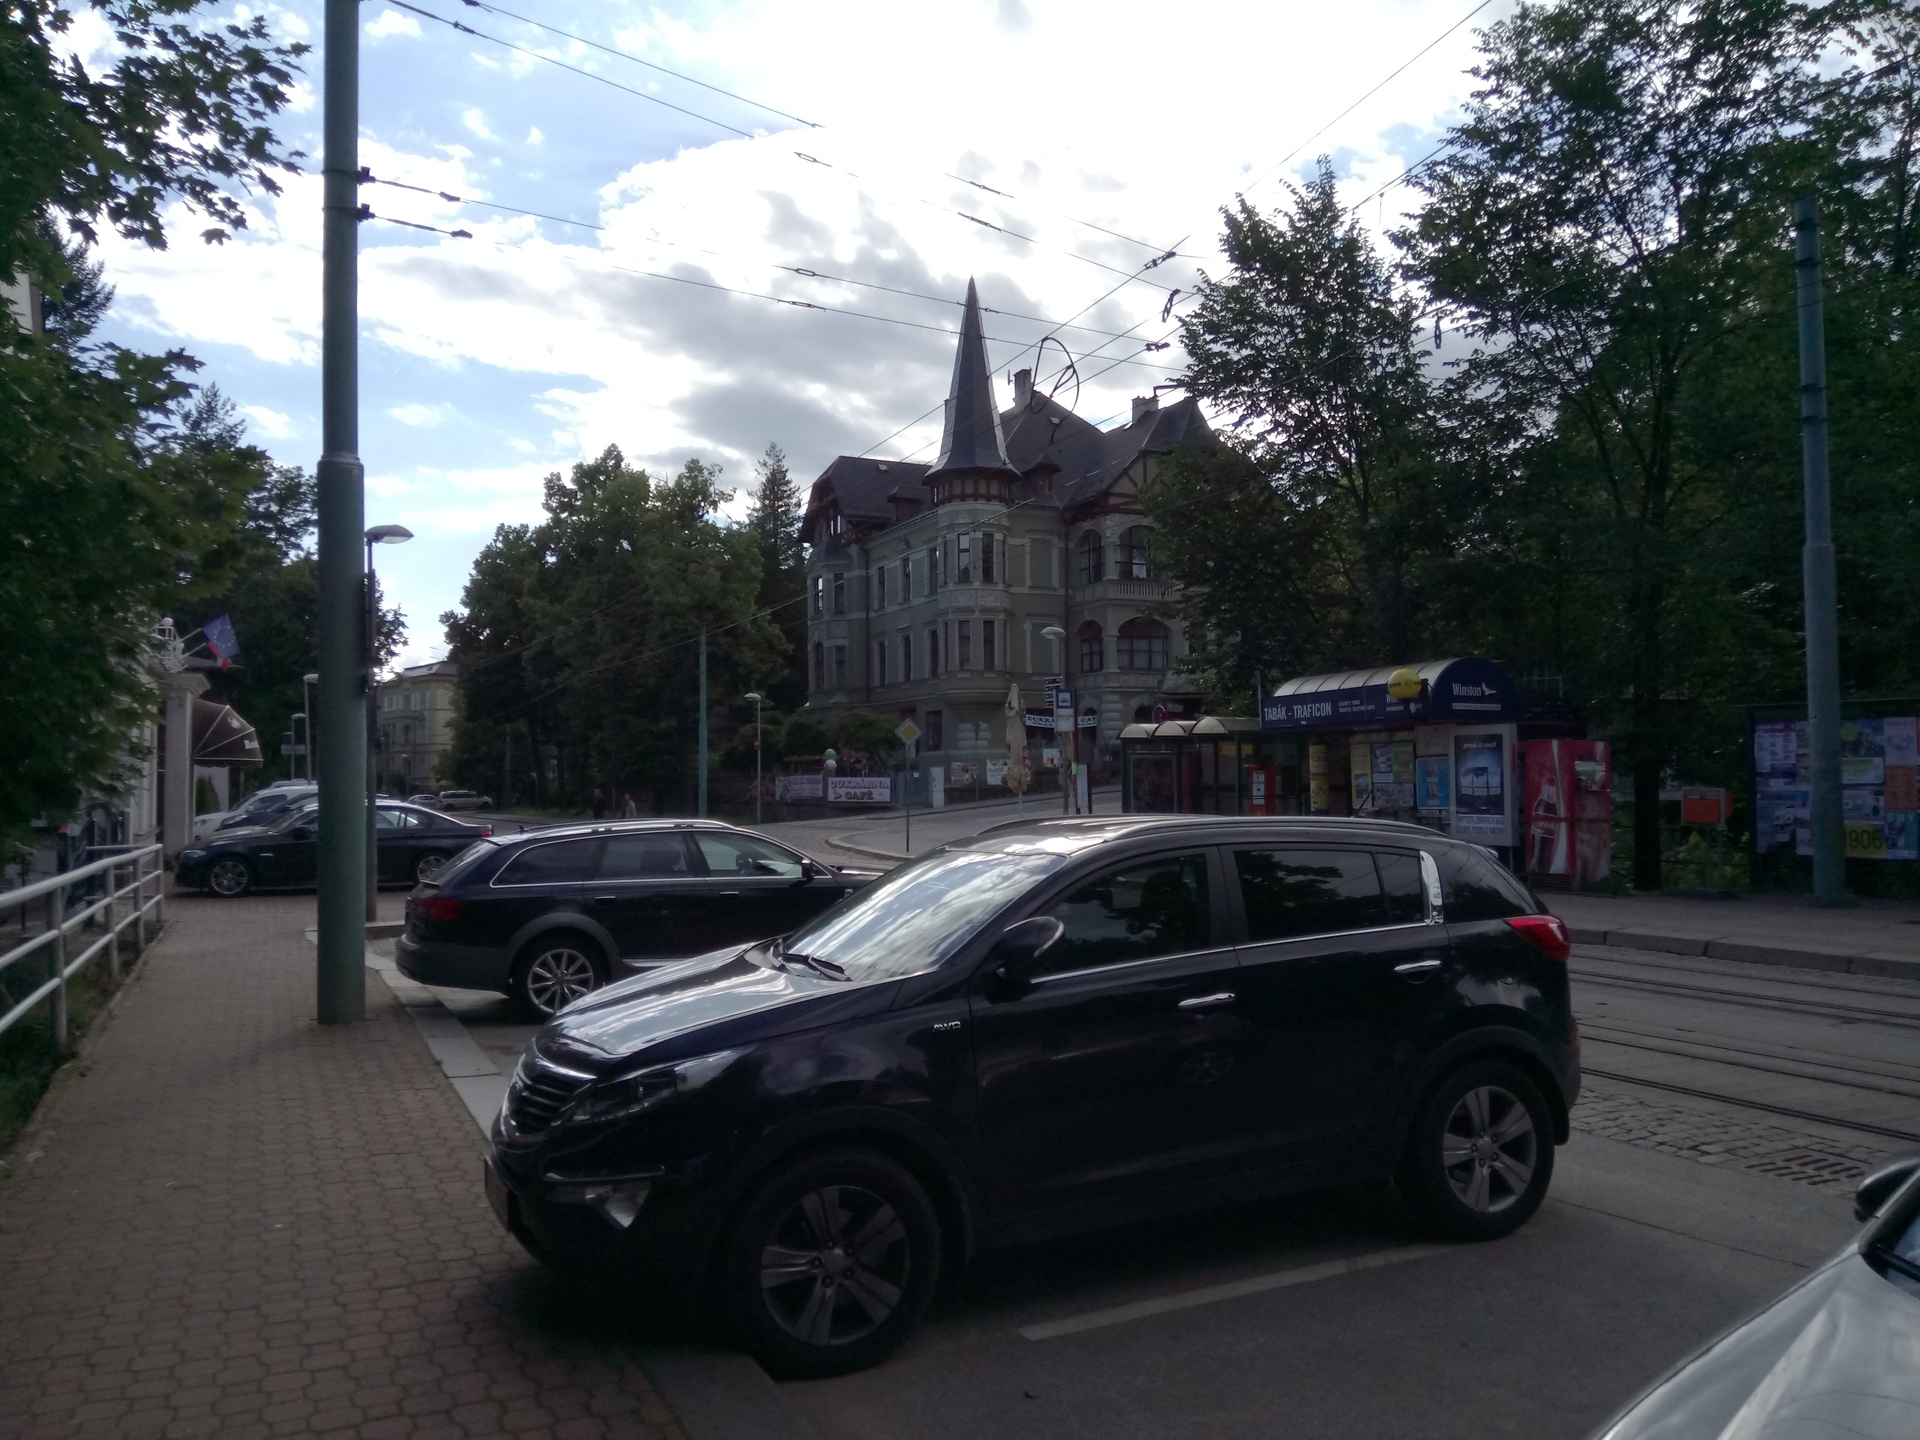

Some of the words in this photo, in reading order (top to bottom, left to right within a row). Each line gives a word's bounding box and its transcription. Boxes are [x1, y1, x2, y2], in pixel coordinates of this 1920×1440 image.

[1452, 683, 1482, 697] Winston
[1263, 703, 1287, 721] TABÁK
[1293, 702, 1332, 719] TRAFICON
